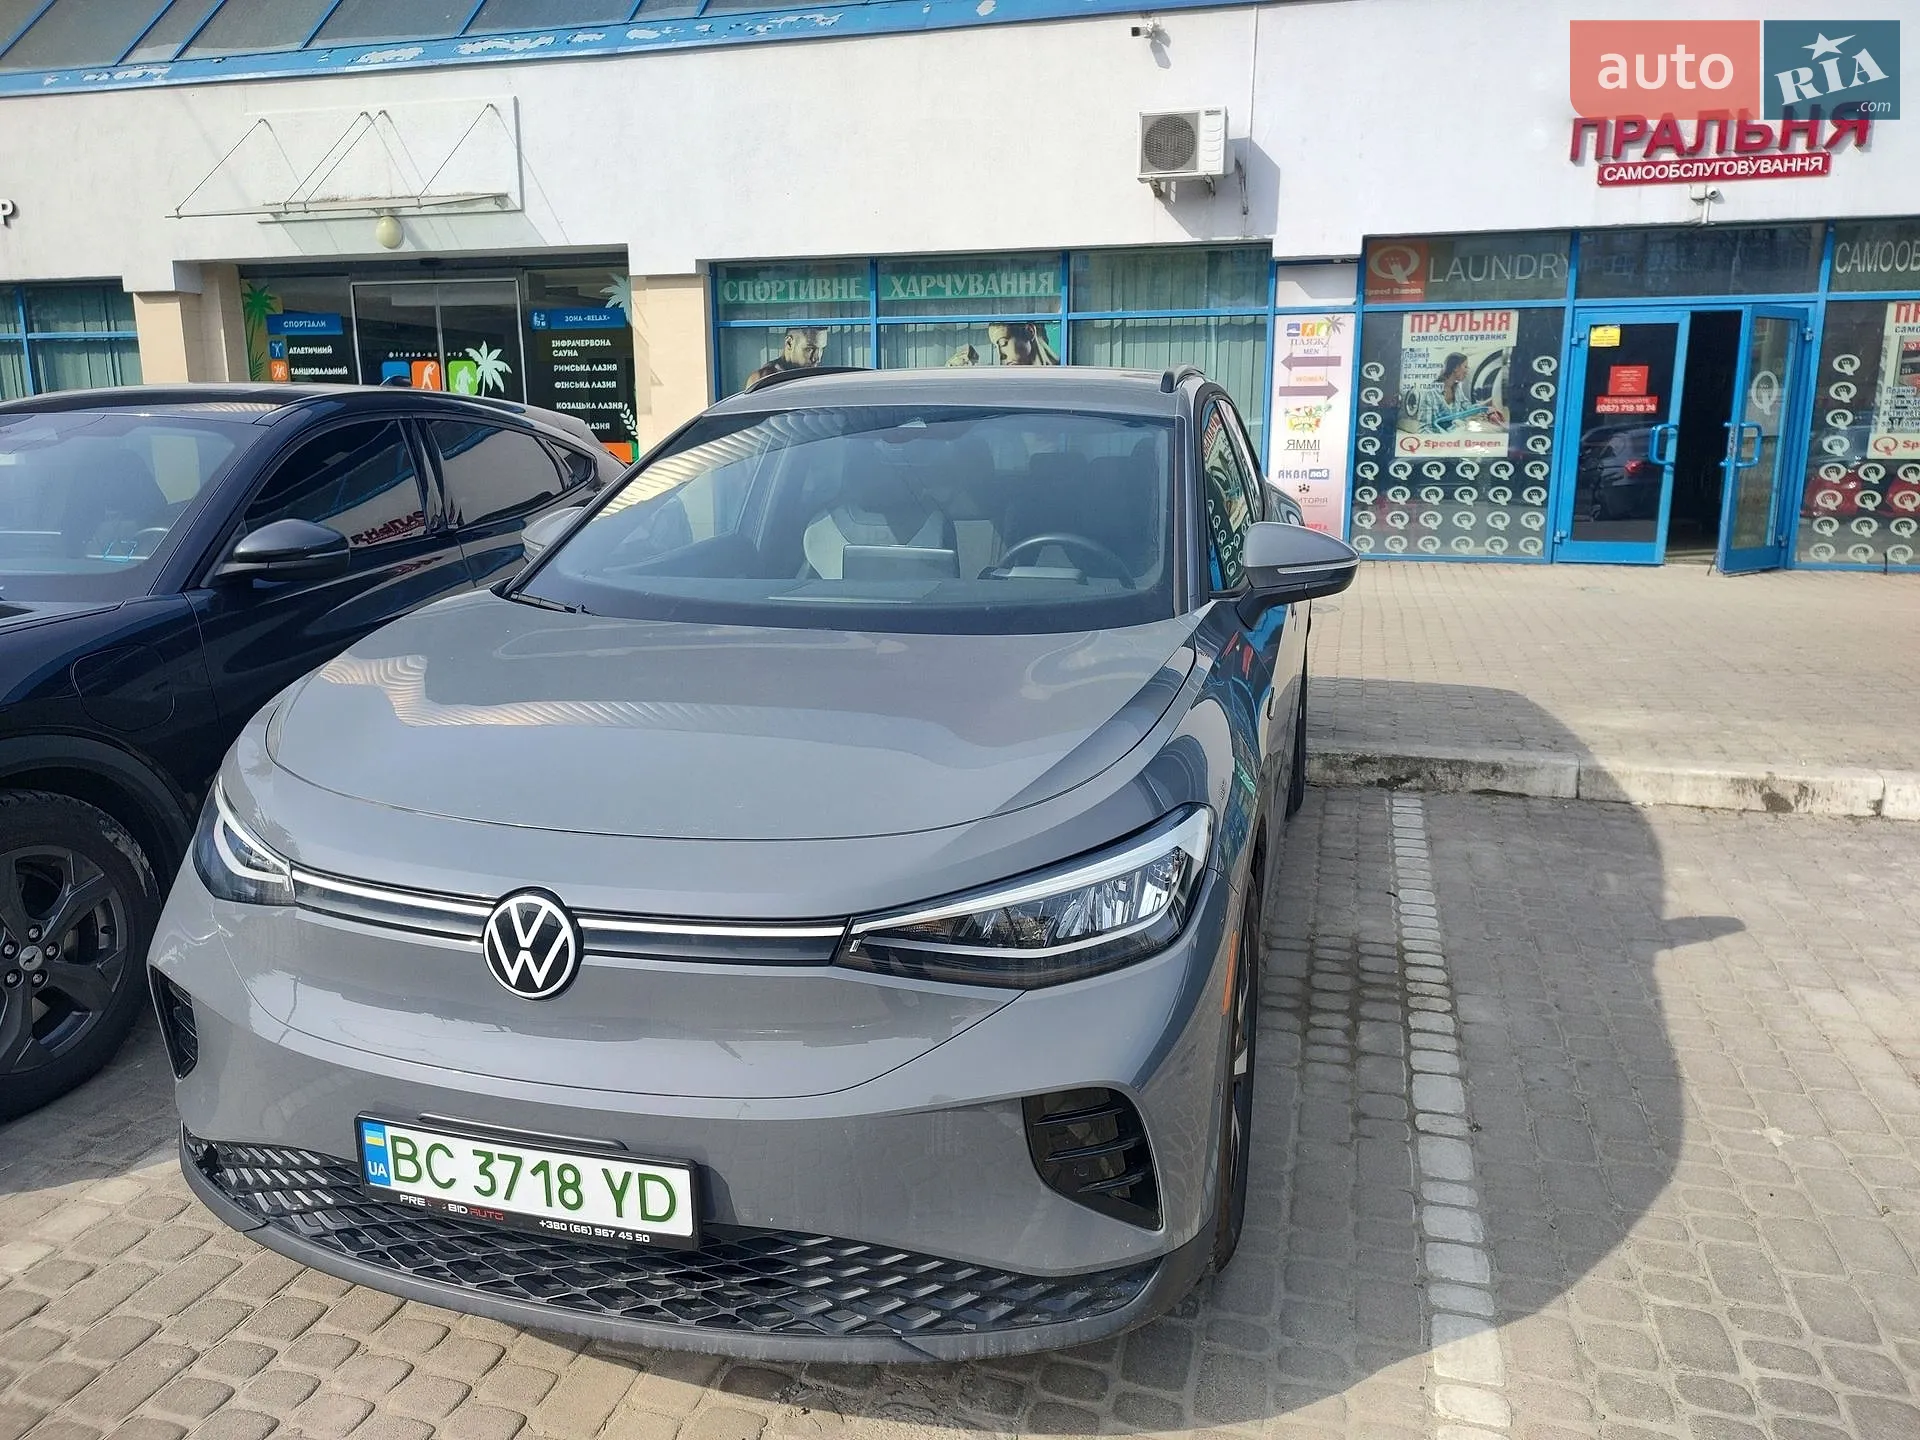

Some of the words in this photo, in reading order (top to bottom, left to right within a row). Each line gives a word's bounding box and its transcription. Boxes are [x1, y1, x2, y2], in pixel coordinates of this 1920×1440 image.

[1570, 102, 1873, 162] ПРАЛЬНЯ
[1603, 156, 1824, 182] САМООБСЛУГОВУВАННЯ
[723, 277, 863, 301] СПОРТИВНЕ
[891, 272, 1055, 298] ХАРЧУВАННЯ
[283, 319, 326, 329] СПОРТЗАЛИ
[1410, 311, 1511, 333] ПРАЛЬНЯ
[551, 339, 611, 347] ІНФРАЧЕРВОНА
[1411, 333, 1508, 343] самообслуговування
[289, 345, 333, 355] АТЛЕТИЧНИЙ
[291, 364, 348, 375] ТАНЦЮВАЛЬНИЙ
[553, 364, 591, 372] РИМСЬКА
[554, 381, 590, 389] ФІНСЬКА
[597, 402, 623, 410] ЛАЗНЯ
[1424, 440, 1460, 449] Speed
[368, 1160, 388, 1178] UA
[390, 1135, 457, 1190] BC
[472, 1149, 584, 1211] 3718
[601, 1167, 677, 1223] YD
[539, 1219, 567, 1231] +380
[570, 1223, 593, 1236] (66)
[595, 1226, 616, 1238] 967
[618, 1230, 633, 1241] 45
[635, 1233, 650, 1243] 50
